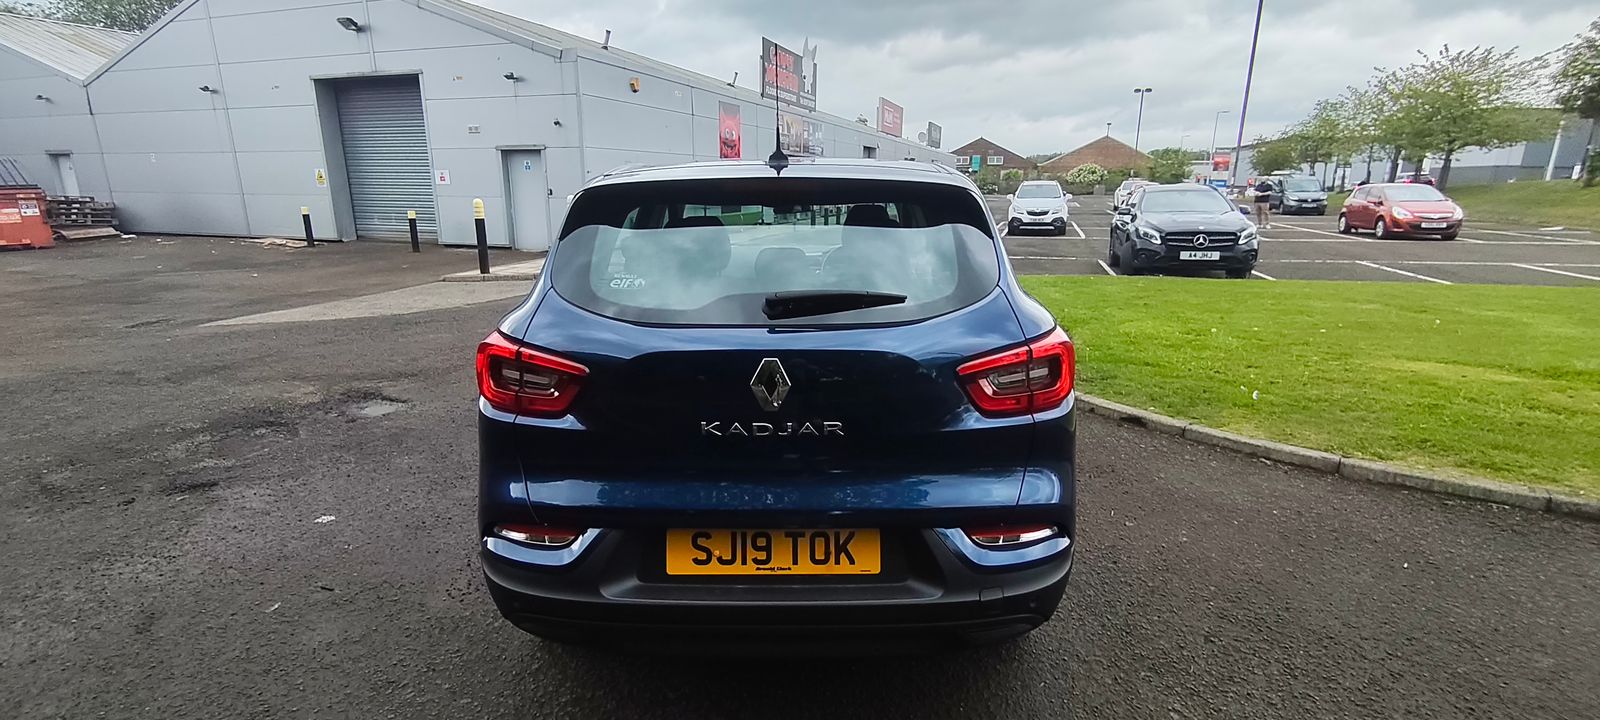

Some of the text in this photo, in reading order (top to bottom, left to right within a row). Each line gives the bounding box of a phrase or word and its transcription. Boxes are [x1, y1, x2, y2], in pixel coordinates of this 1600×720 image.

[610, 278, 634, 288] elf
[700, 421, 845, 436] KADJAR
[690, 530, 856, 566] SJ19 TOK
